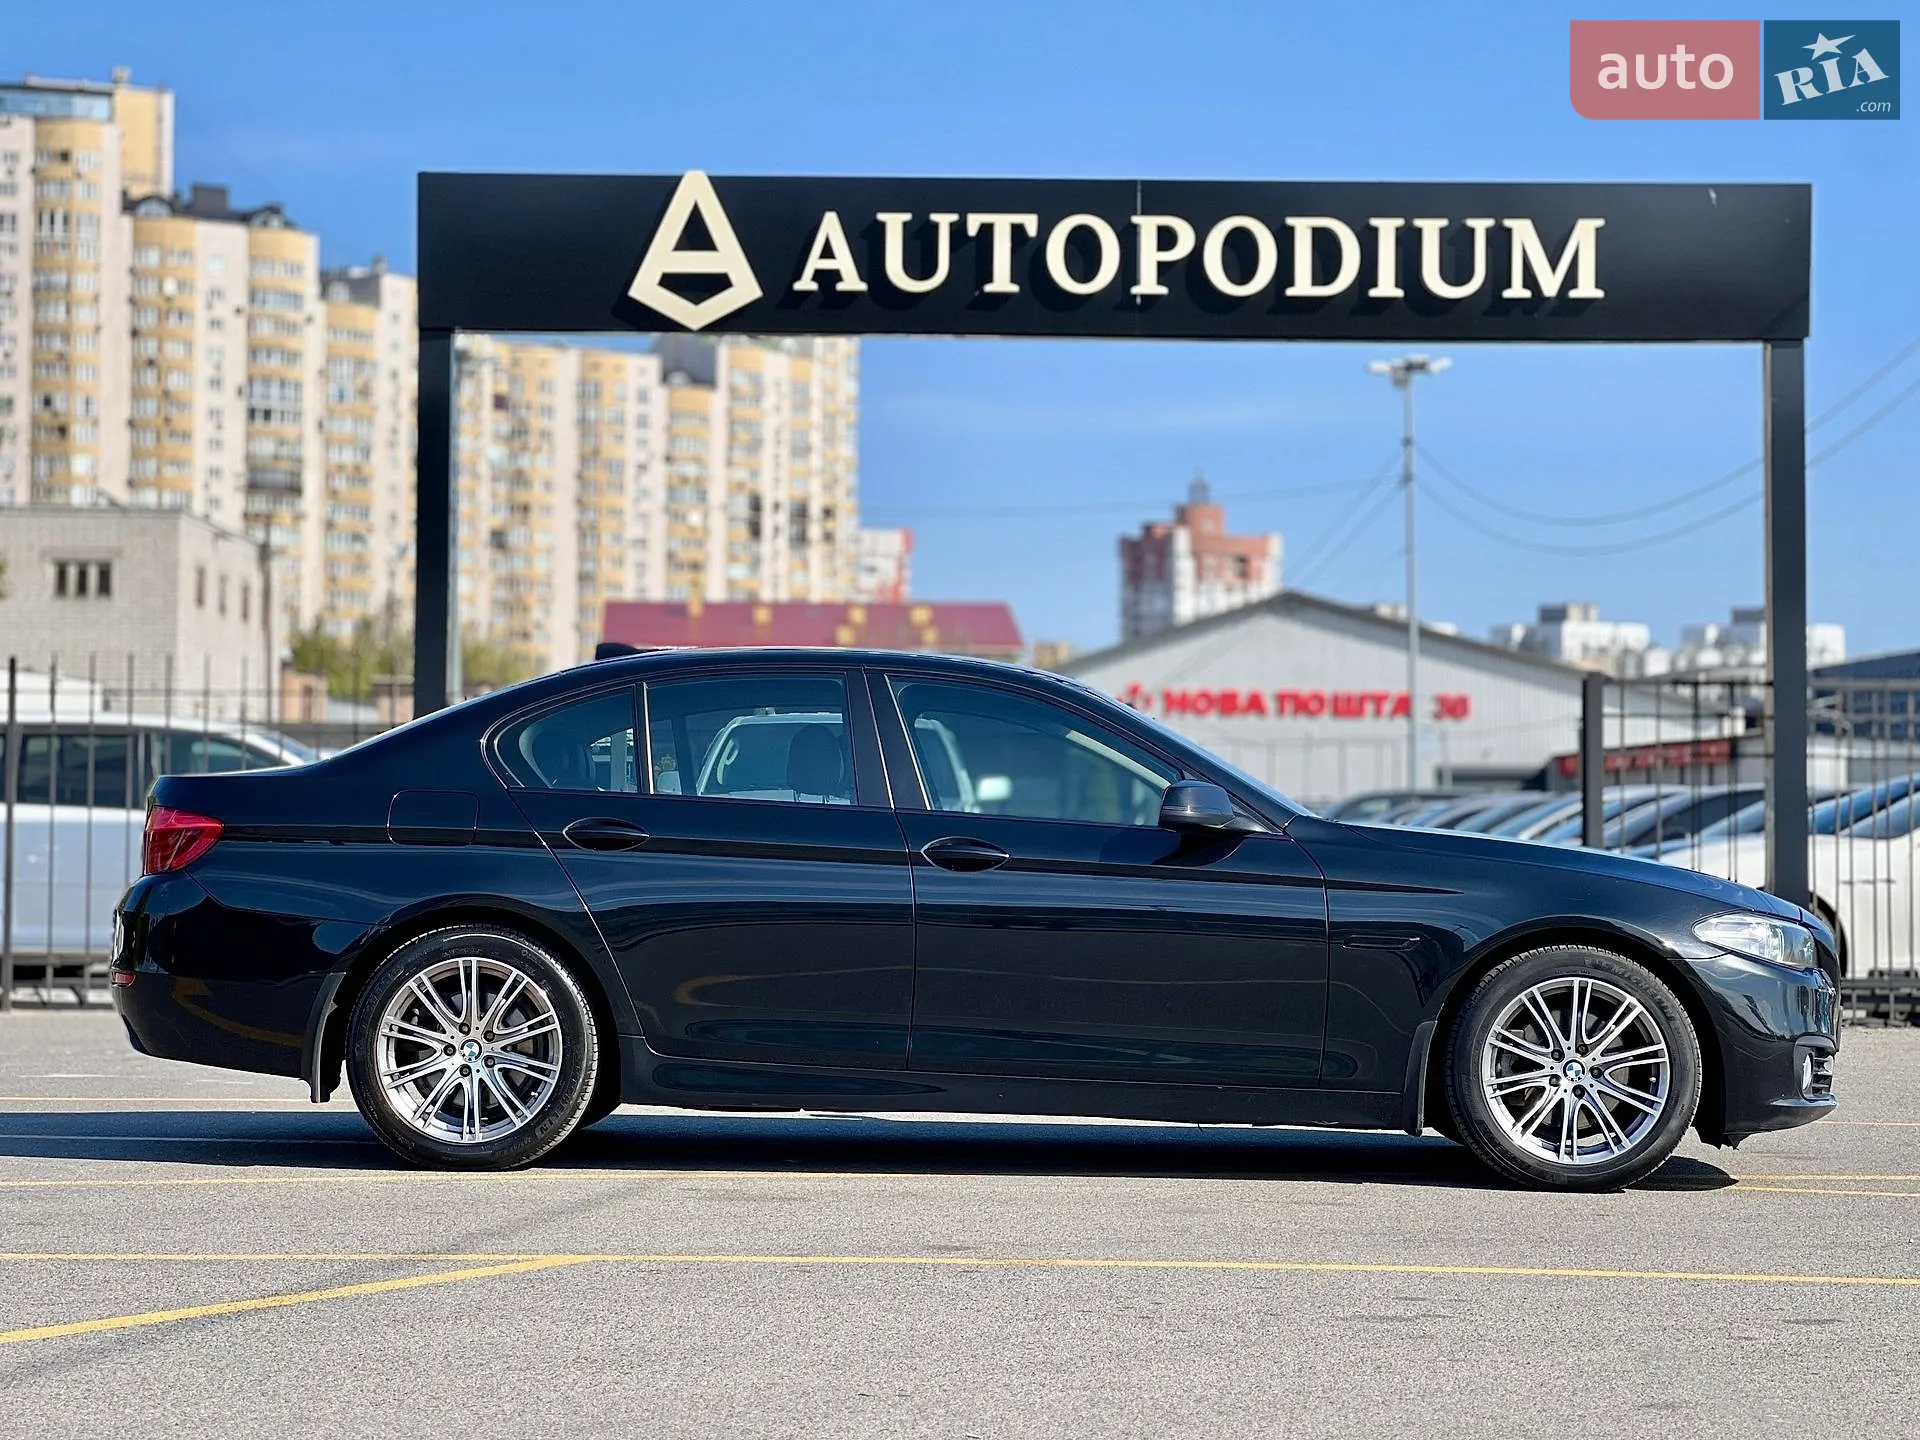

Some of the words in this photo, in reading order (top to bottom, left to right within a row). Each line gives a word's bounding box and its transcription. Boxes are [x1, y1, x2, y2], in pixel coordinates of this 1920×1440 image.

[792, 210, 1607, 301] AUTOPODIUM
[1163, 688, 1269, 716] НОВА
[1276, 689, 1412, 718] ПОШТА
